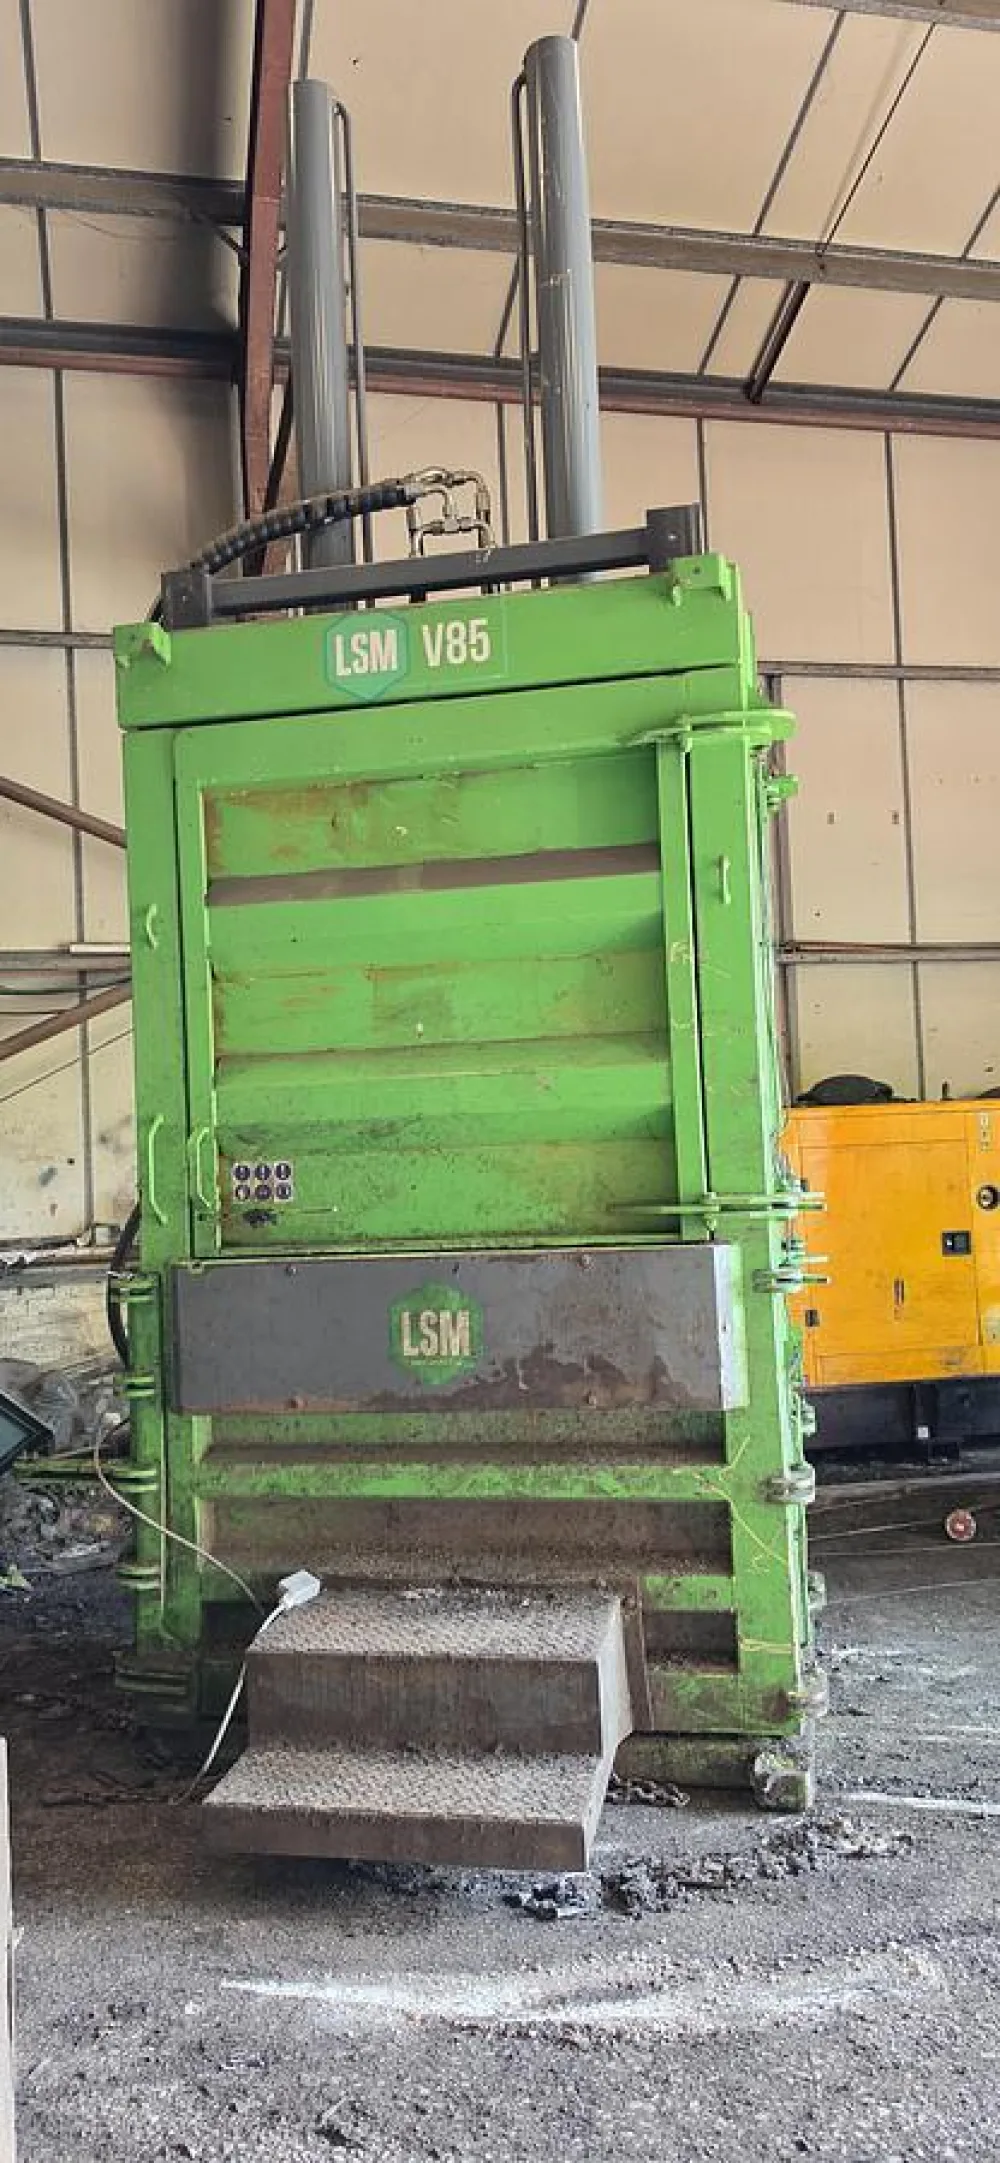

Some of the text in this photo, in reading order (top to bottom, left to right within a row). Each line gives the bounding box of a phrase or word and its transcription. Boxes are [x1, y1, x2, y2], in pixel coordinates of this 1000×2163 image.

[334, 618, 491, 676] LSM V85
[401, 1309, 470, 1356] LSM
